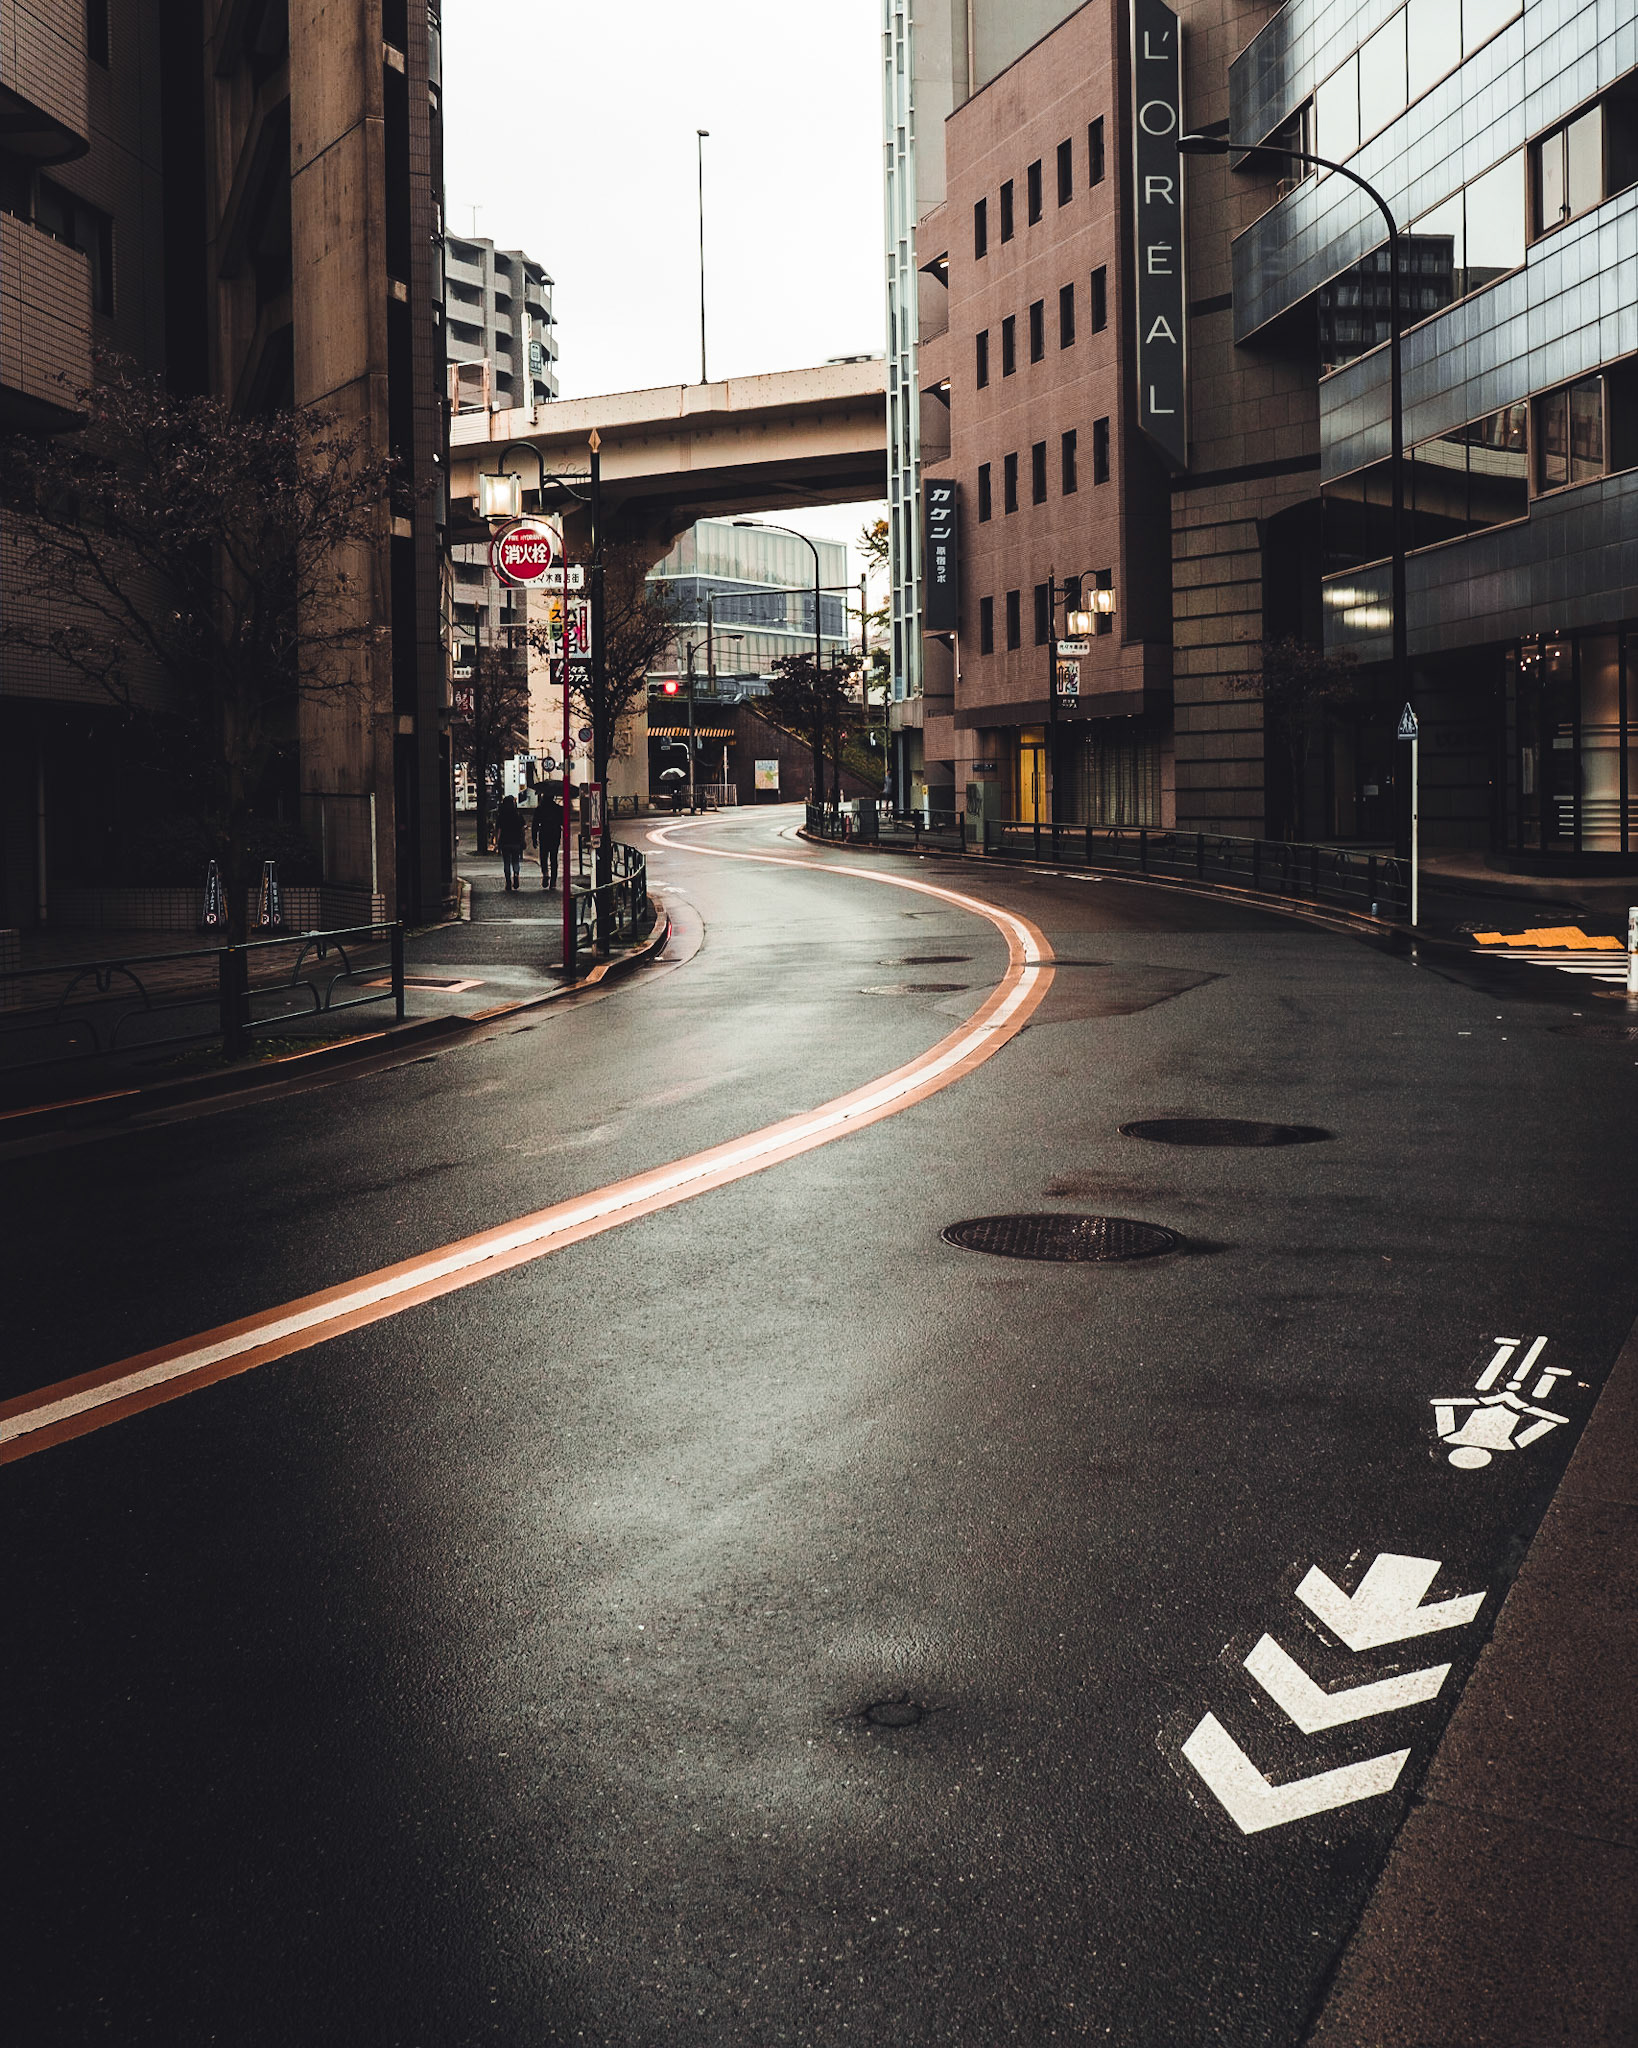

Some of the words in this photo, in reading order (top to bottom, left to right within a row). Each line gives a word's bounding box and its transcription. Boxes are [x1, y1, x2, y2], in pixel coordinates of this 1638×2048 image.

[1139, 31, 1177, 414] L'ORÉAL
[930, 488, 951, 539] カケン
[504, 543, 548, 564] 消火栓
[935, 546, 947, 584] 原宿ラボ
